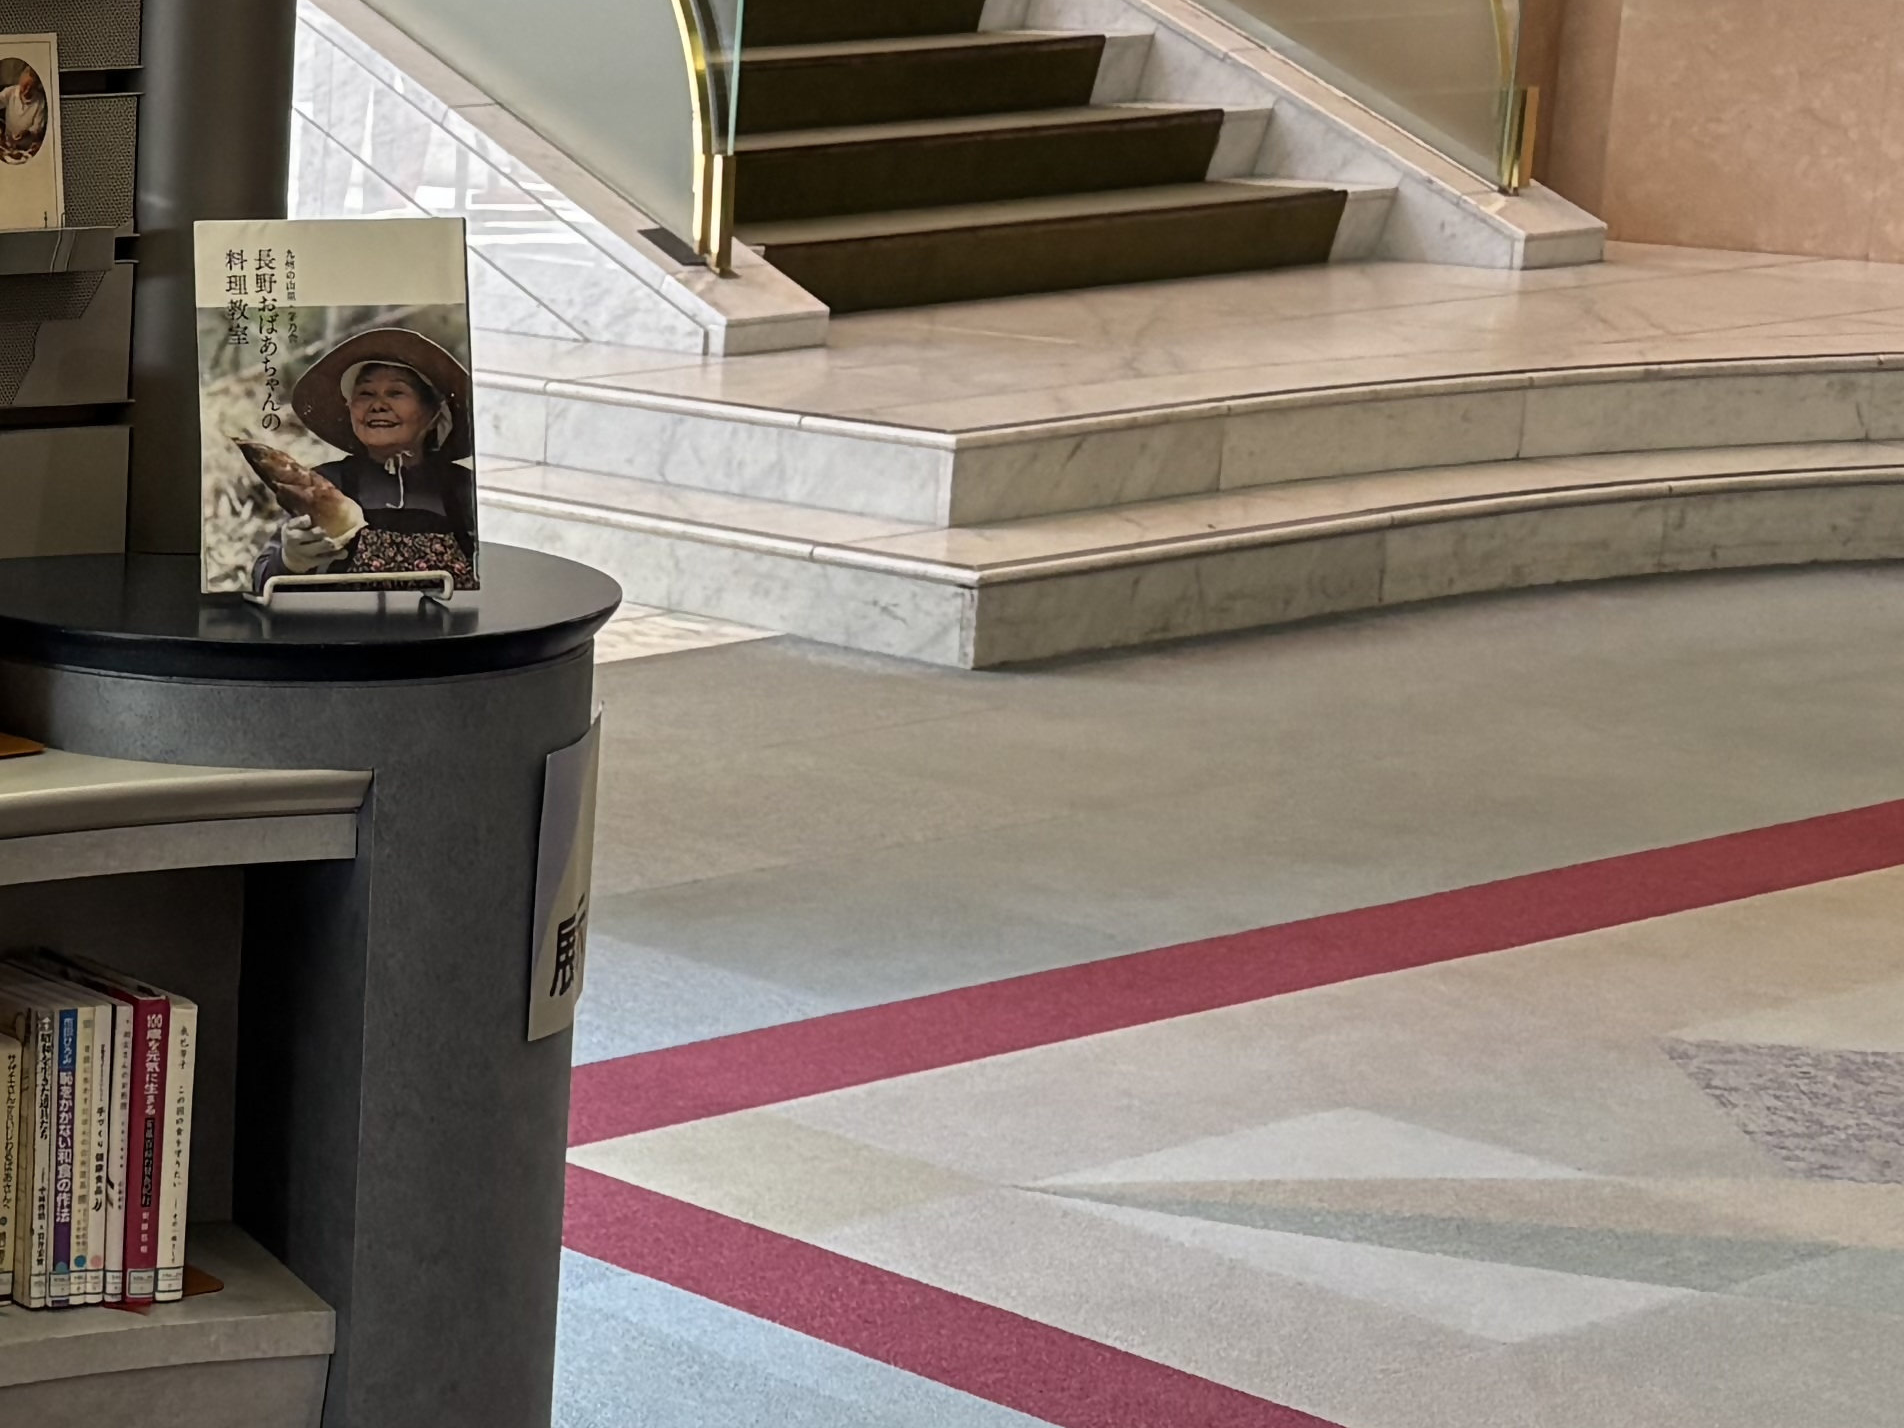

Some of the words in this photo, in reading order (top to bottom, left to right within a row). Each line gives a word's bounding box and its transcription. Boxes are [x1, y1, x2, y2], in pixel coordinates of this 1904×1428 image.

[225, 248, 250, 346] 料理教室
[254, 248, 281, 432] 長野おばあちゃんの
[55, 1072, 74, 1224] 恥をかかない和食の作法
